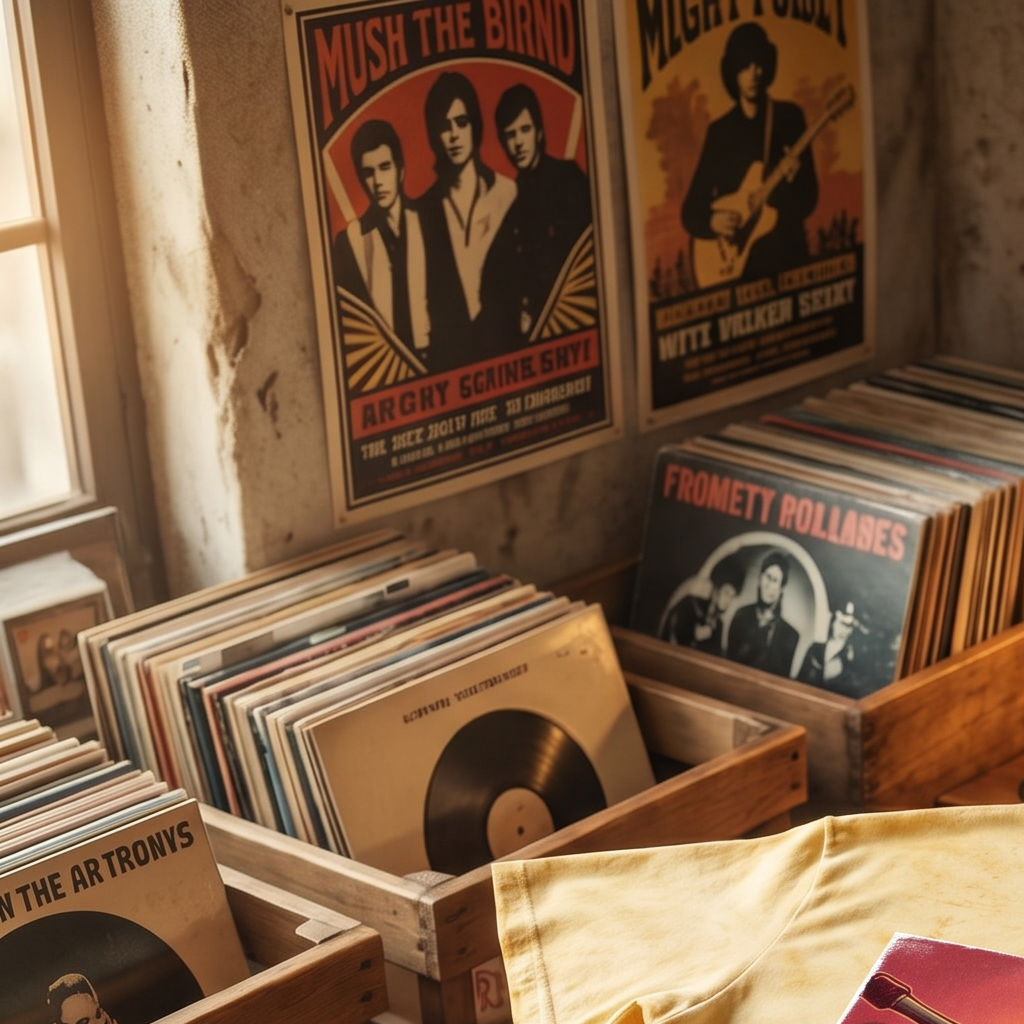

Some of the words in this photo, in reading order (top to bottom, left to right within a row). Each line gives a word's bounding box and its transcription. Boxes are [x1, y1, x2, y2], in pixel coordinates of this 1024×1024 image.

[313, 14, 409, 132] MUSH
[412, 3, 476, 58] THE
[662, 463, 777, 525] FROMETY
[15, 871, 67, 913] THE
